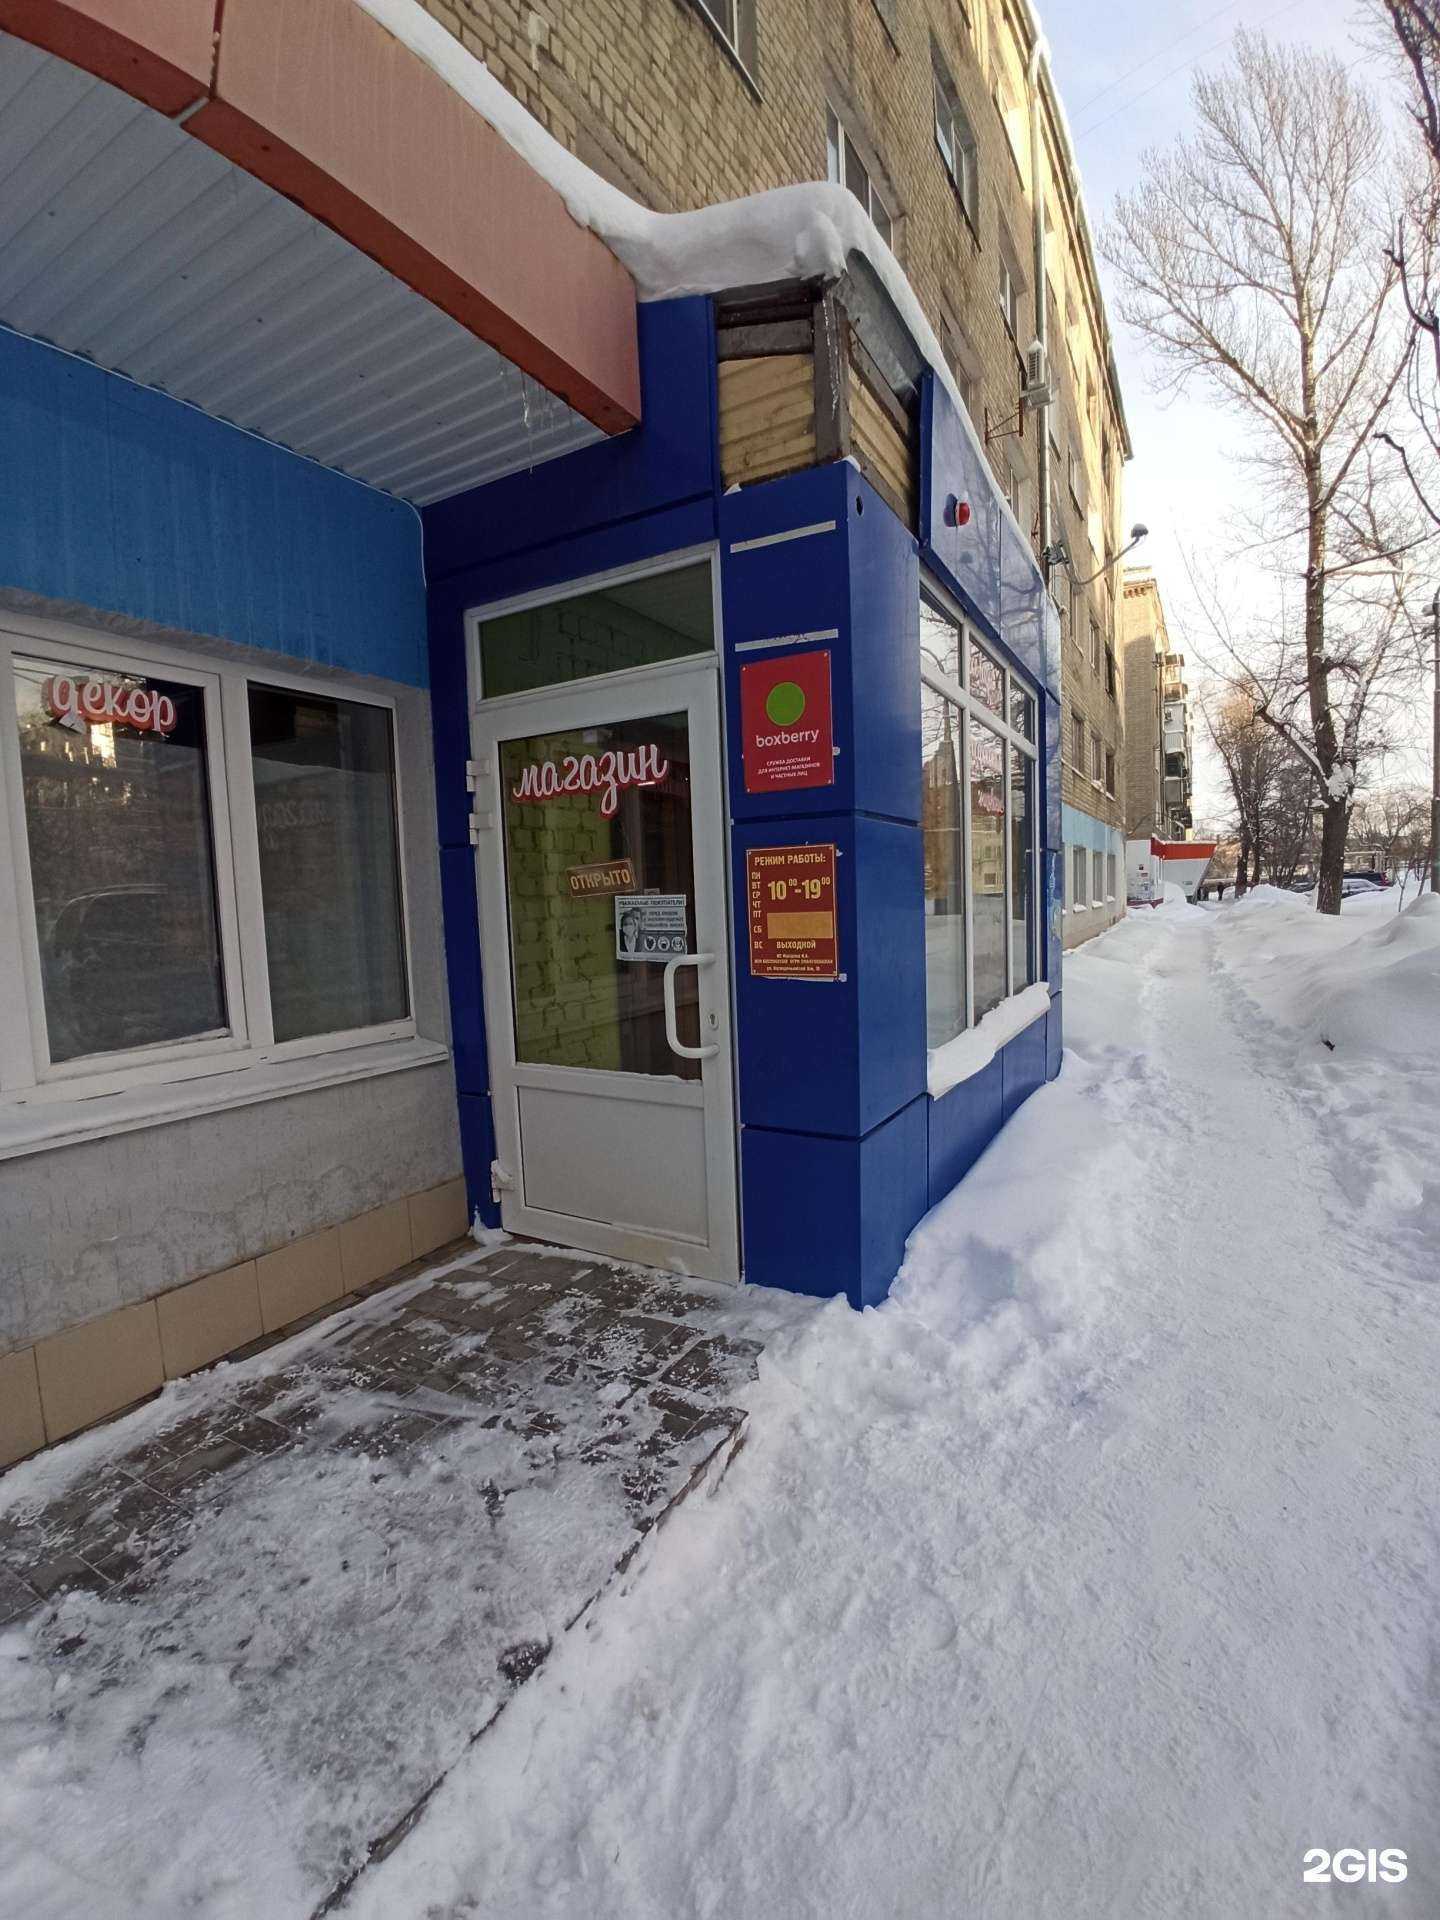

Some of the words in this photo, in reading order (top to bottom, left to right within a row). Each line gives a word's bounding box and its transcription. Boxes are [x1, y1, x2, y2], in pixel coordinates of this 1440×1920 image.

[50, 674, 177, 735] декор
[755, 729, 819, 747] boxberry
[512, 743, 668, 816] магазин
[754, 855, 785, 866] РЕЖИМ
[787, 853, 826, 864] РАБОТЫ:
[570, 868, 631, 890] ОТКРЫТО
[752, 881, 761, 889] ВТ
[752, 891, 761, 899] СР
[752, 900, 761, 908] ЧТ
[753, 910, 761, 918] ПТ
[753, 925, 762, 934] СБ
[754, 941, 763, 949] ВС
[776, 940, 816, 950] ВЫХОДНОЙ
